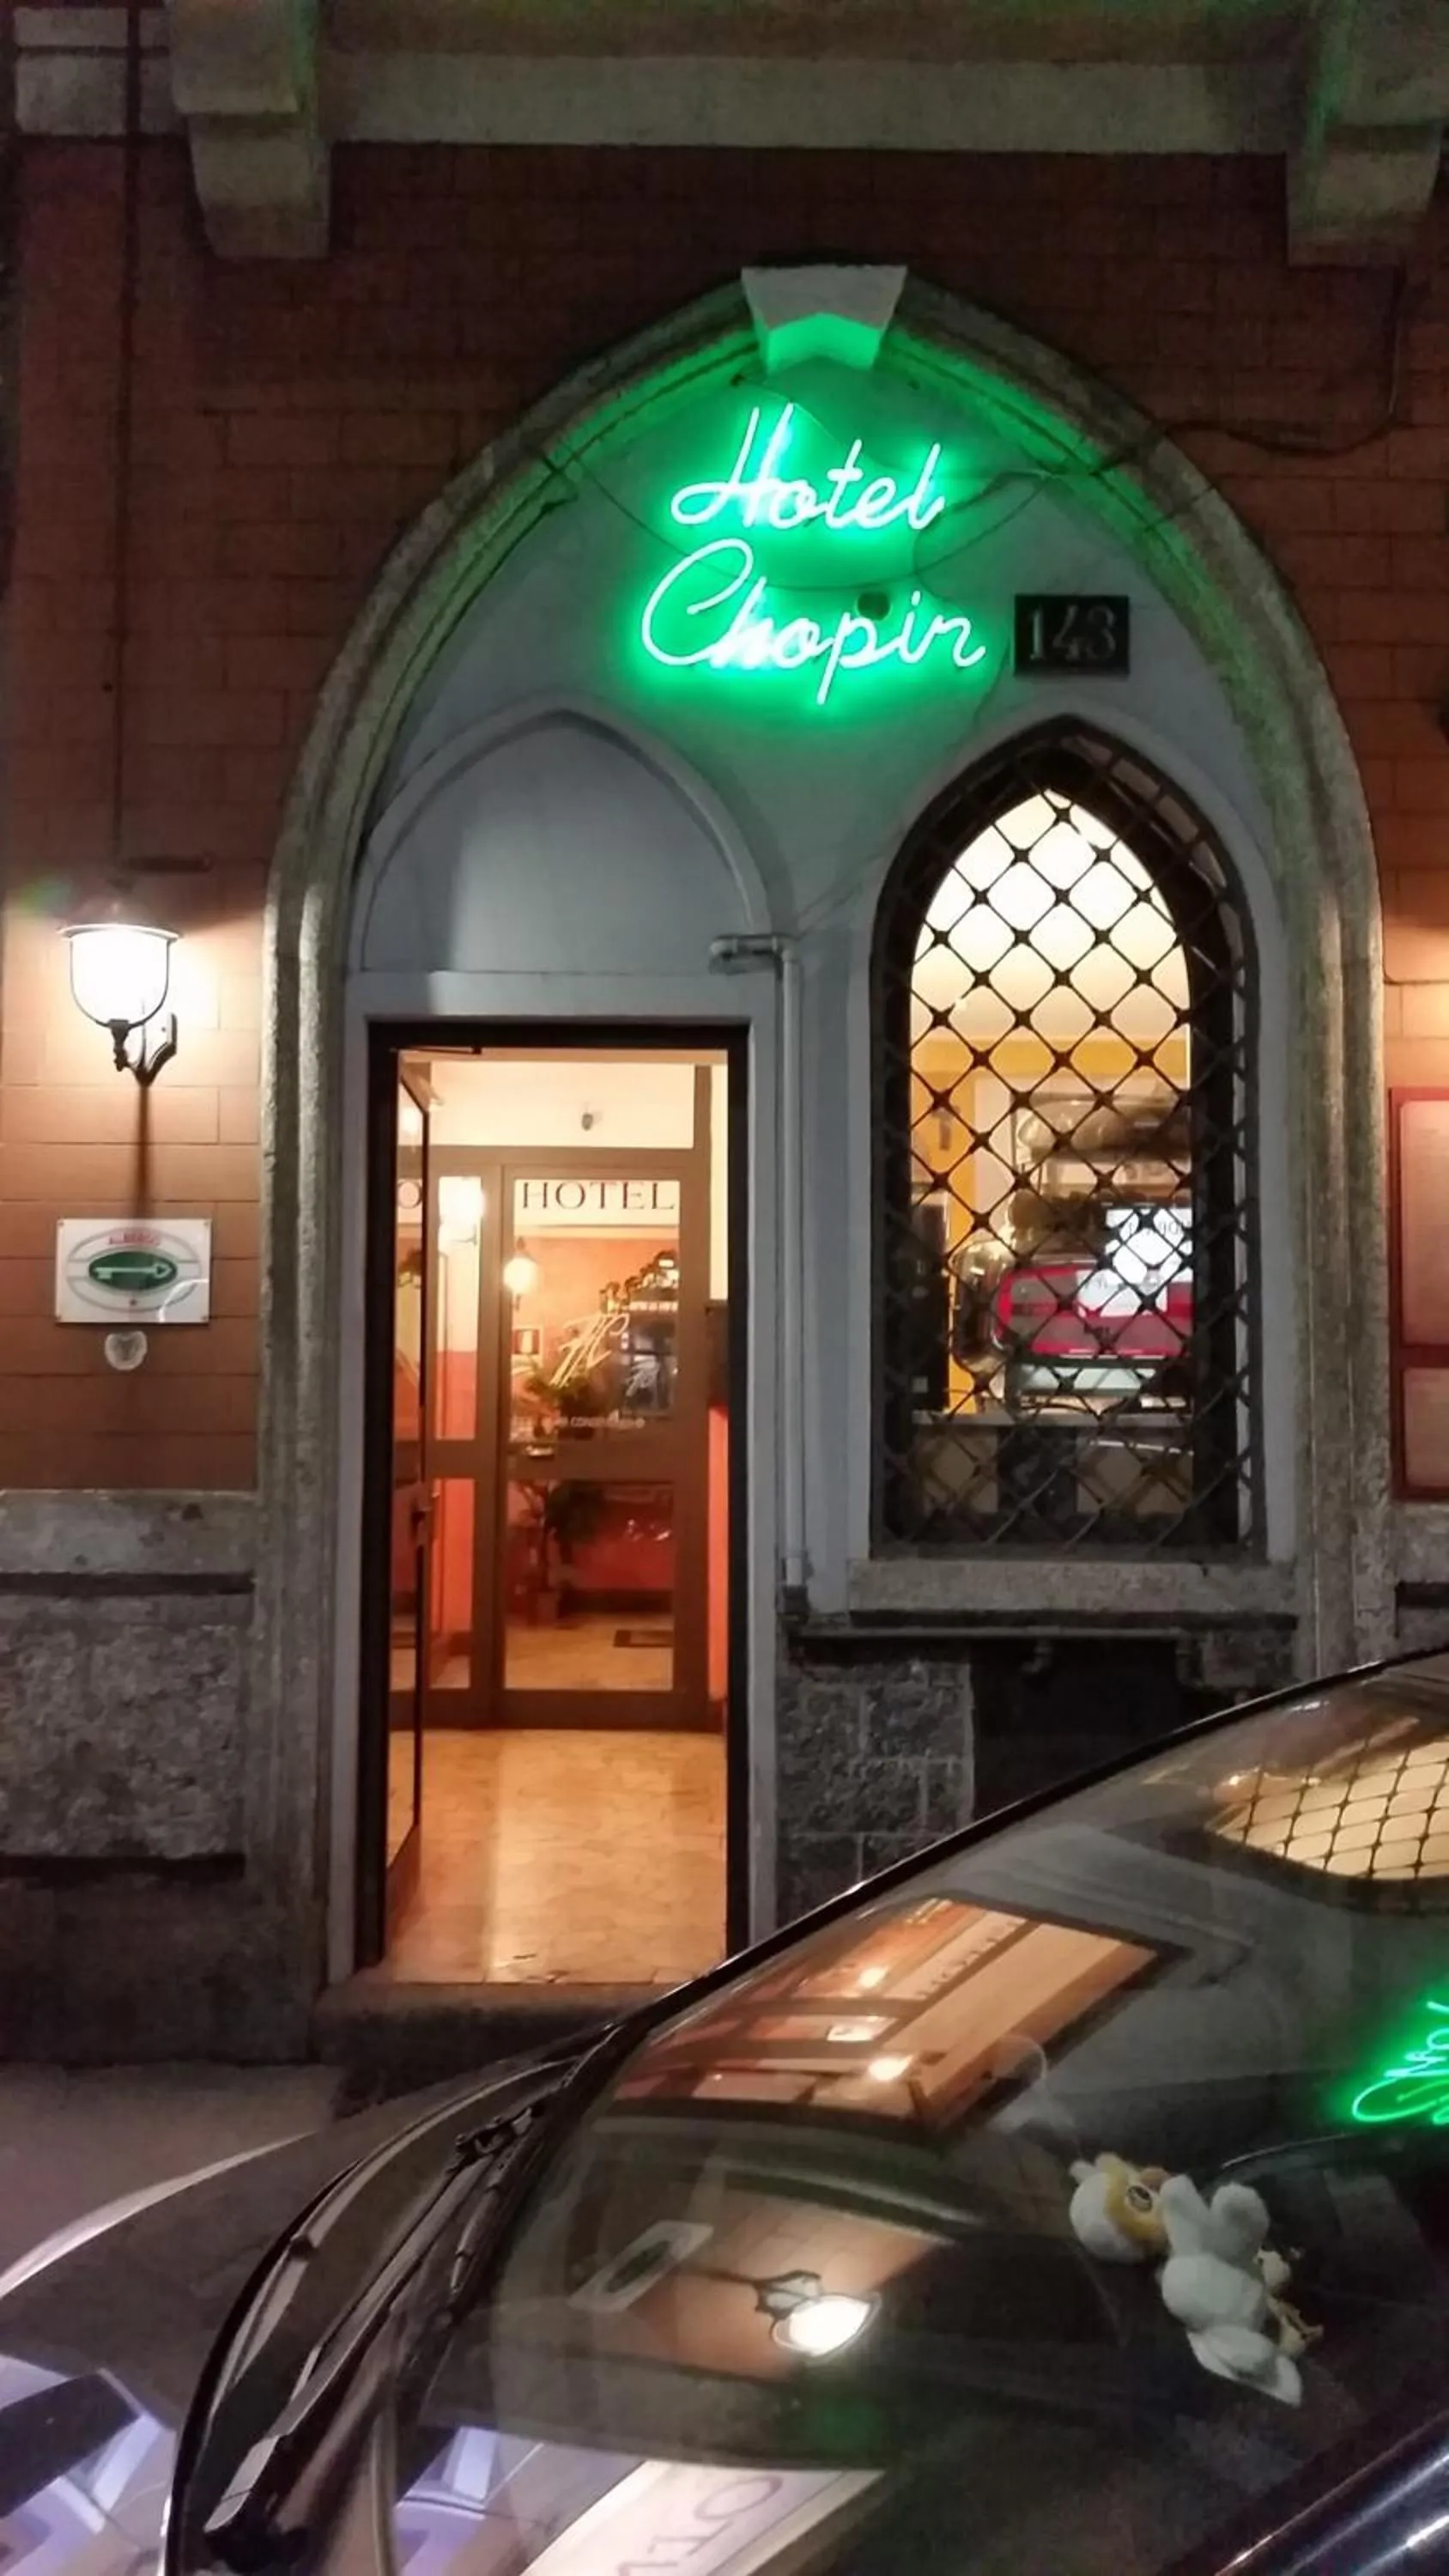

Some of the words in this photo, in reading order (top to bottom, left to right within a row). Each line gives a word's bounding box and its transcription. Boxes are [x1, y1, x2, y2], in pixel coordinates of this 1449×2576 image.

[672, 404, 946, 530] Hotel
[640, 538, 986, 705] Chopin
[1029, 604, 1118, 660] 143
[522, 1181, 675, 1209] HOTEL
